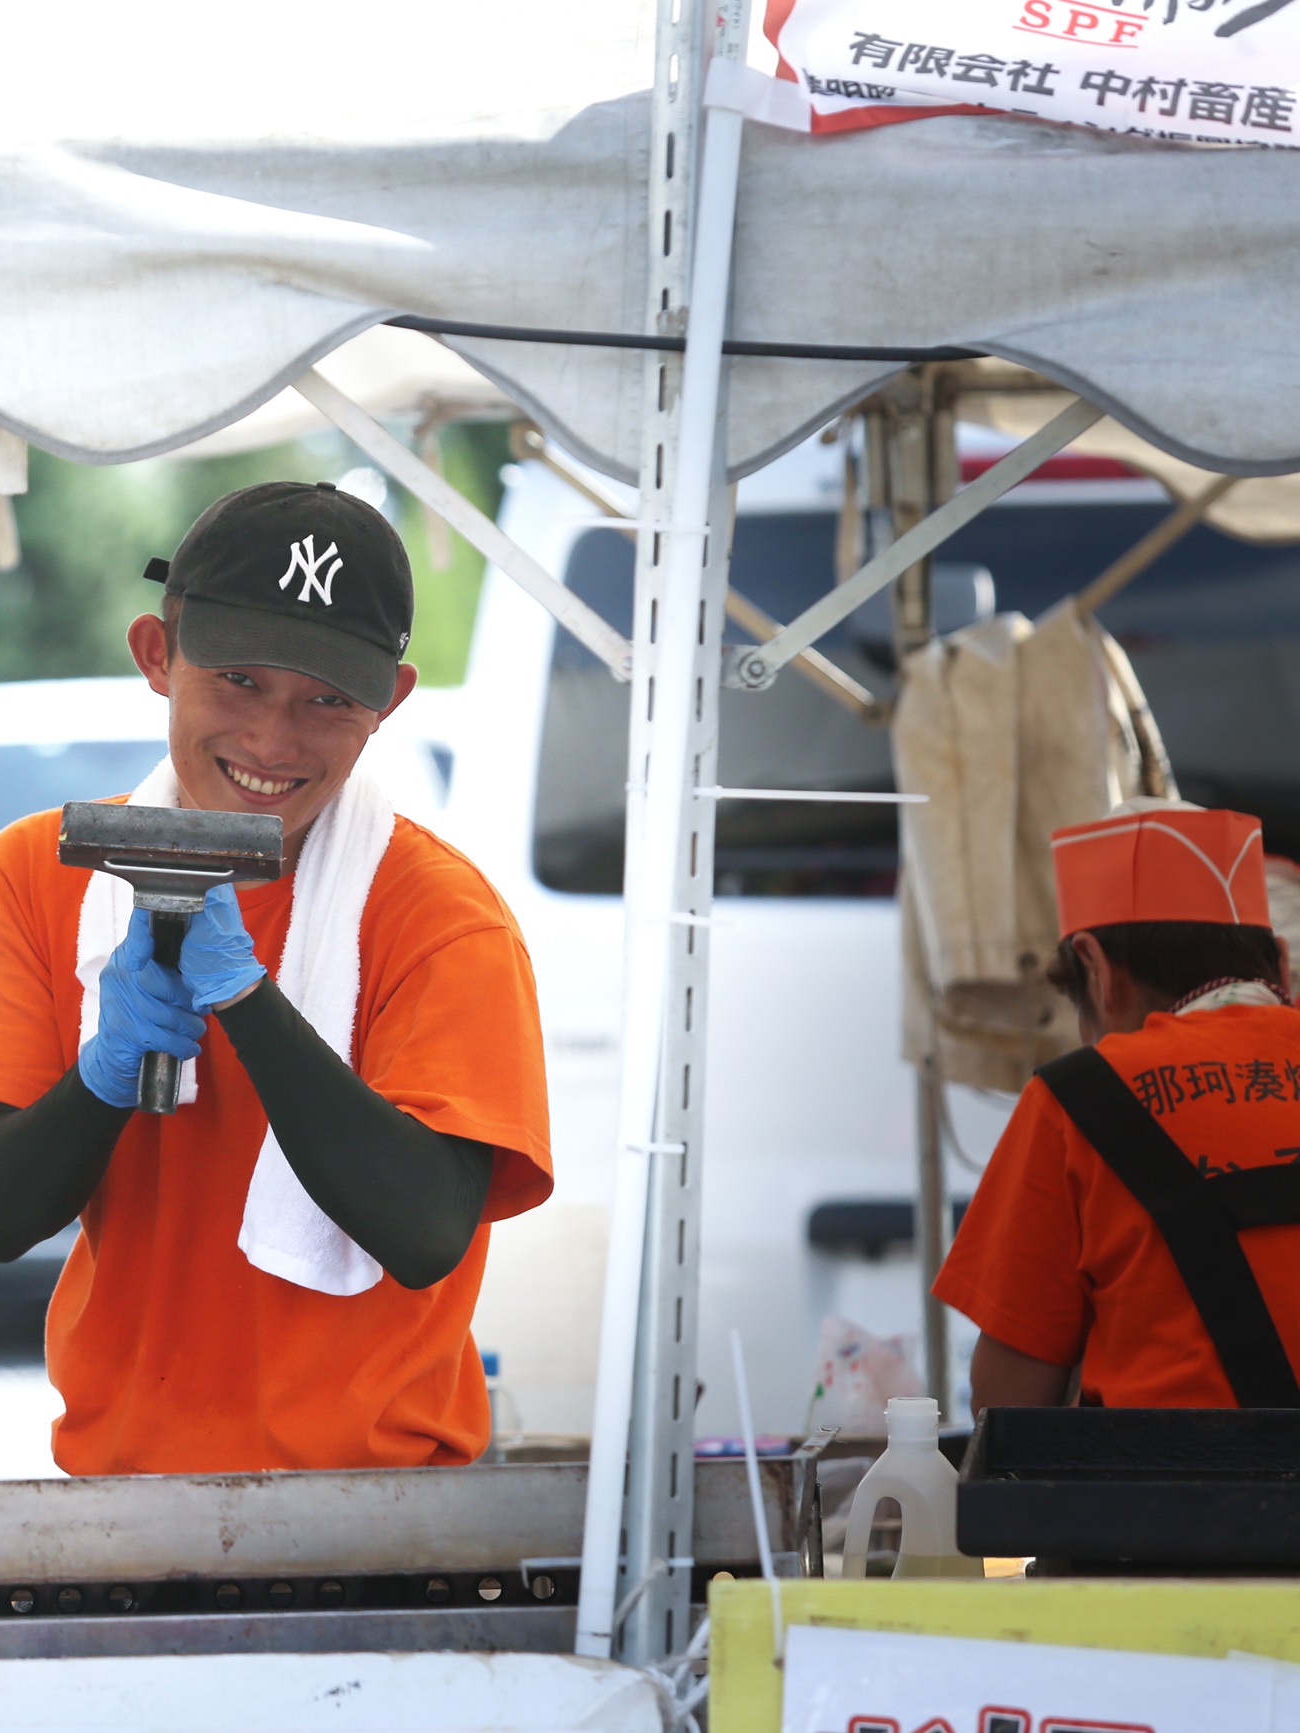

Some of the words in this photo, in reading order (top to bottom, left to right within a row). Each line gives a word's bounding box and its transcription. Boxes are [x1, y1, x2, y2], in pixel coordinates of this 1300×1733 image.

[1019, 0, 1143, 43] SPF
[849, 31, 1061, 96] 有限会社
[1079, 69, 1297, 132] 中村畜産
[278, 534, 344, 606] NY
